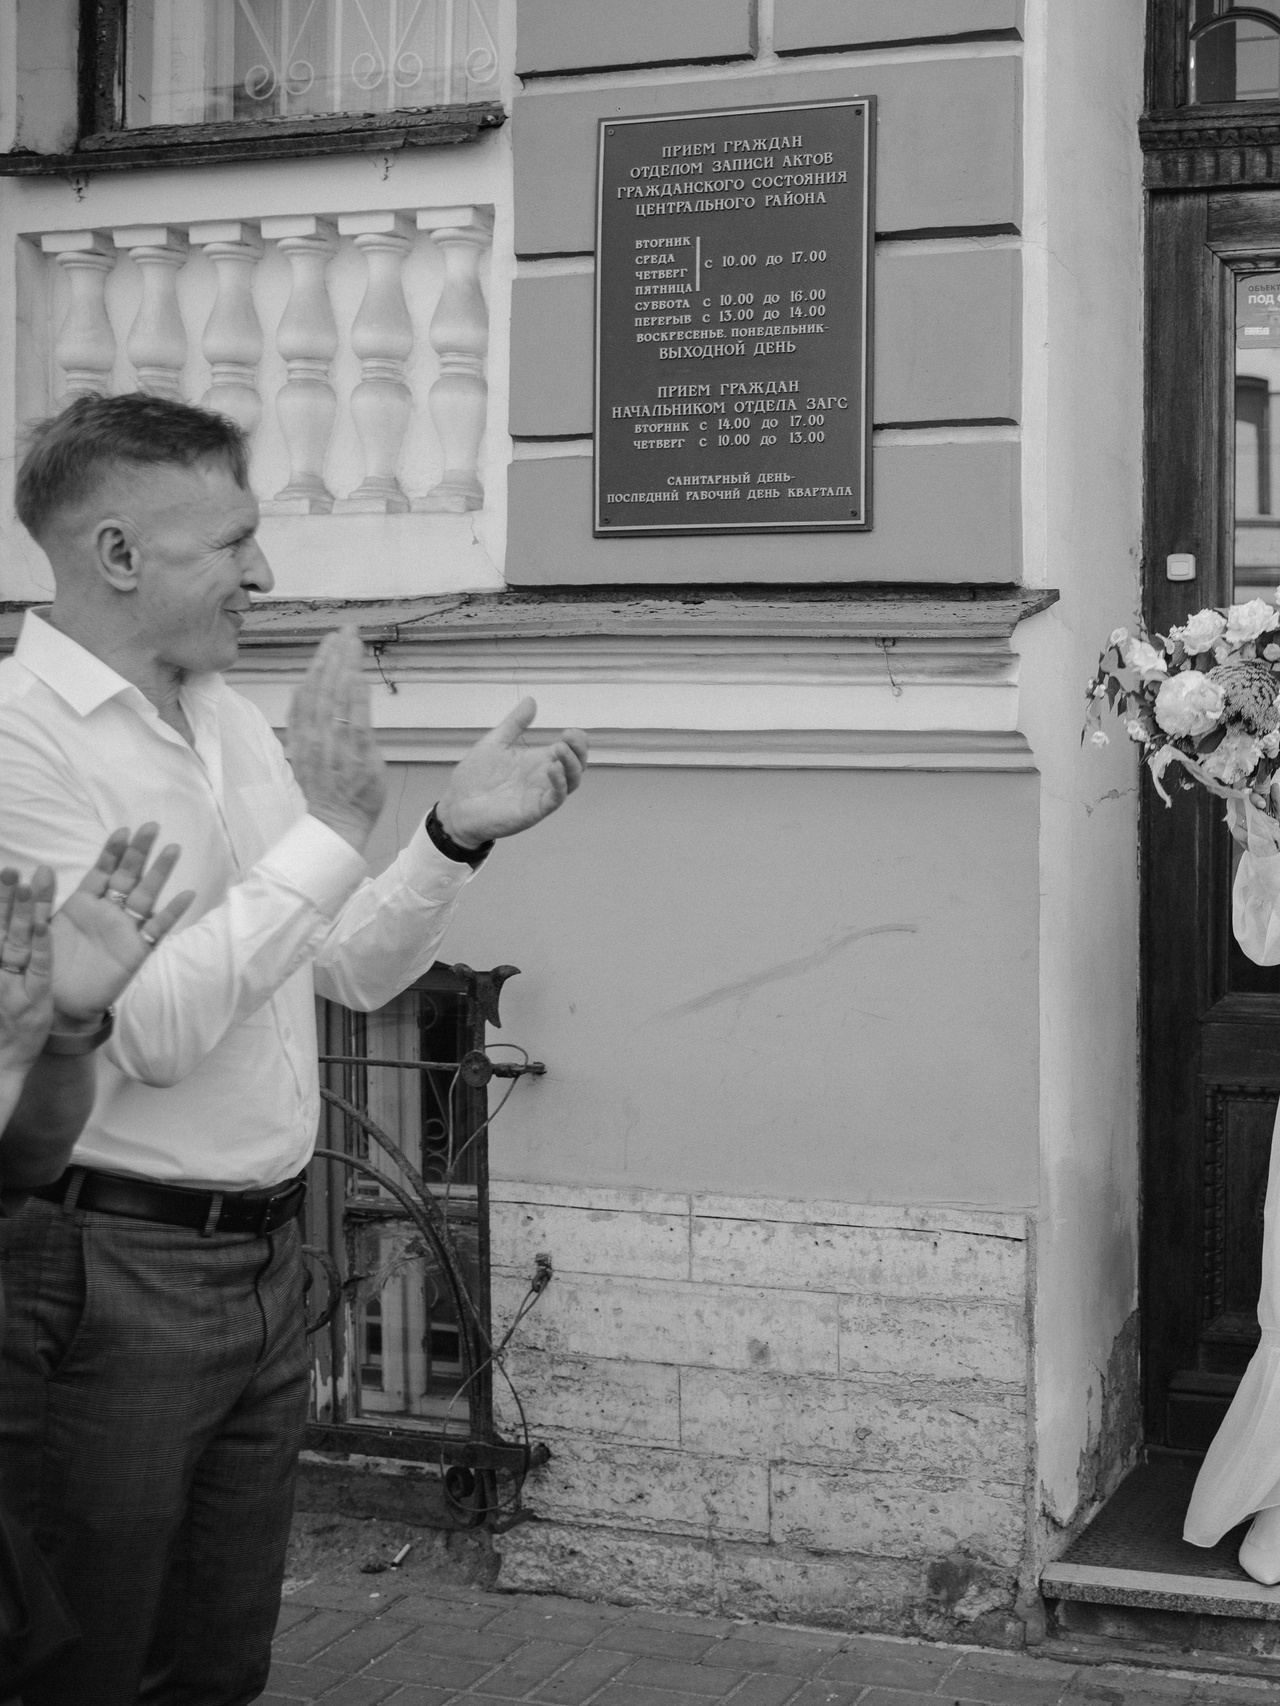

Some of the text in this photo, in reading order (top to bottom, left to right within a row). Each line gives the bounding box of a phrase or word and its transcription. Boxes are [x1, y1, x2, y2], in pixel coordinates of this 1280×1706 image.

[662, 135, 803, 158] ПРИЕМ ГРАЖДАН
[630, 151, 833, 179] ОТДЕЛОМ ЗАПИСИ АКТОВ
[617, 170, 847, 199] ГРАЖДАНСКОГО СОСТОЯНИЯ
[635, 190, 826, 217] ЦЕНТРАЛЬНОГО РАЙОНА
[635, 236, 691, 249] ВТОРНИК
[635, 253, 675, 265] СРЕДА
[722, 254, 757, 267] 10.00
[791, 249, 827, 263] 17.00
[635, 268, 688, 280] ЧЕТВЕРГ
[635, 283, 693, 296] ПЯТНИЦА
[1248, 284, 1280, 292] ОБЪЕКТ
[634, 299, 691, 311] СУББОТА
[720, 292, 754, 306] 10.00
[790, 288, 826, 302] 16.00
[1248, 294, 1275, 305] ПОД
[634, 314, 692, 327] ПЕРЕРЫВ
[719, 308, 754, 322] 13.00
[790, 304, 826, 318] 14.00
[659, 340, 796, 360] ВЫХОДНОЙ ДЕНЬ
[657, 380, 799, 398] ПРИЕМ ГРАЖДАН
[612, 396, 848, 419] НАЧАЛЬНИКОМ ОТДЕЛА ЗАГС
[634, 422, 690, 434] ВТОРНИК
[718, 417, 751, 430] 14.00
[790, 414, 825, 427] 17.00
[633, 438, 686, 450] ЧЕТВЕРГ
[718, 433, 750, 446] 10.00
[789, 430, 825, 444] 13.00
[666, 471, 751, 486] САНИТАРНЫЙ
[607, 486, 853, 503] ПОСЛЕДНИЙ РАБОЧИЙ ДЕНЬ КВАРТАЛА
